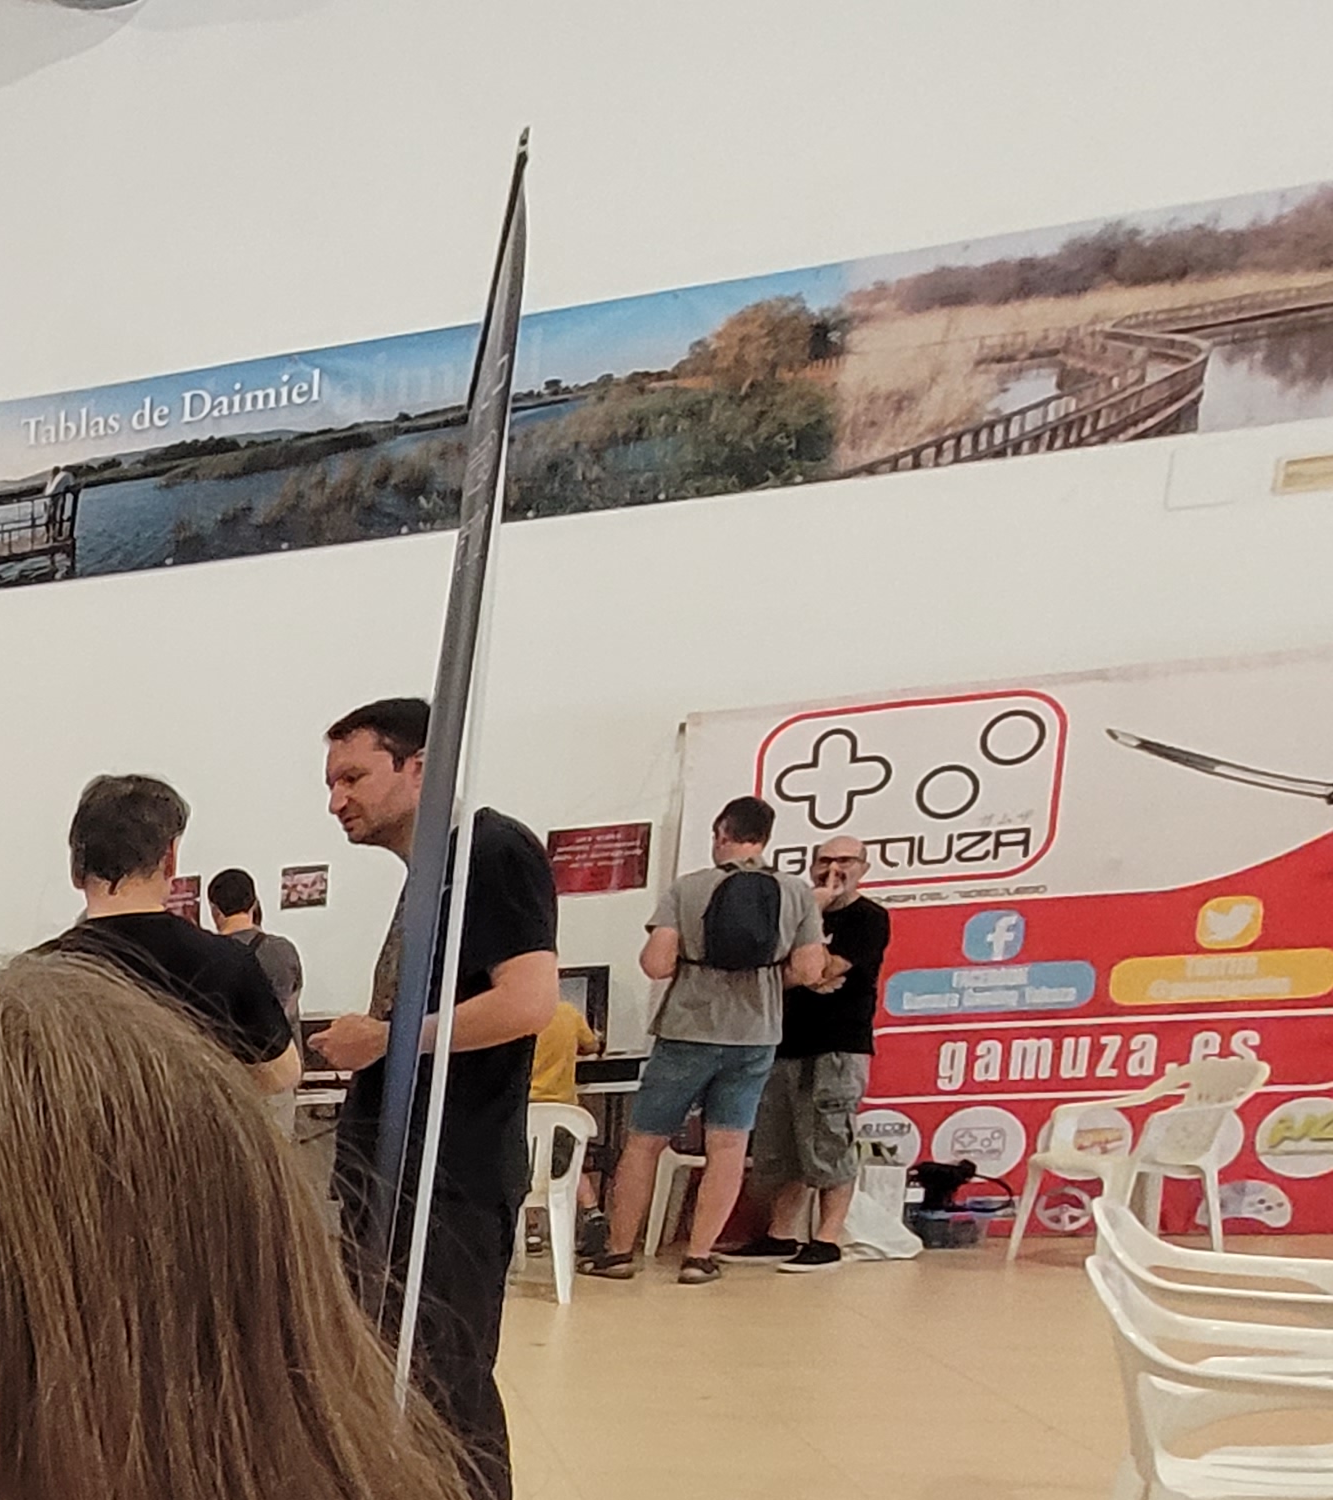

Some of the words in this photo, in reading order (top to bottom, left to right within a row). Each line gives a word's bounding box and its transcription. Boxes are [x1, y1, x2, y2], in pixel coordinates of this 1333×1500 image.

[21, 407, 120, 445] Tablas
[131, 397, 169, 430] de
[180, 368, 322, 423] Daimiel
[773, 828, 1031, 875] GMUZA
[936, 1030, 1261, 1091] gamuza.es
